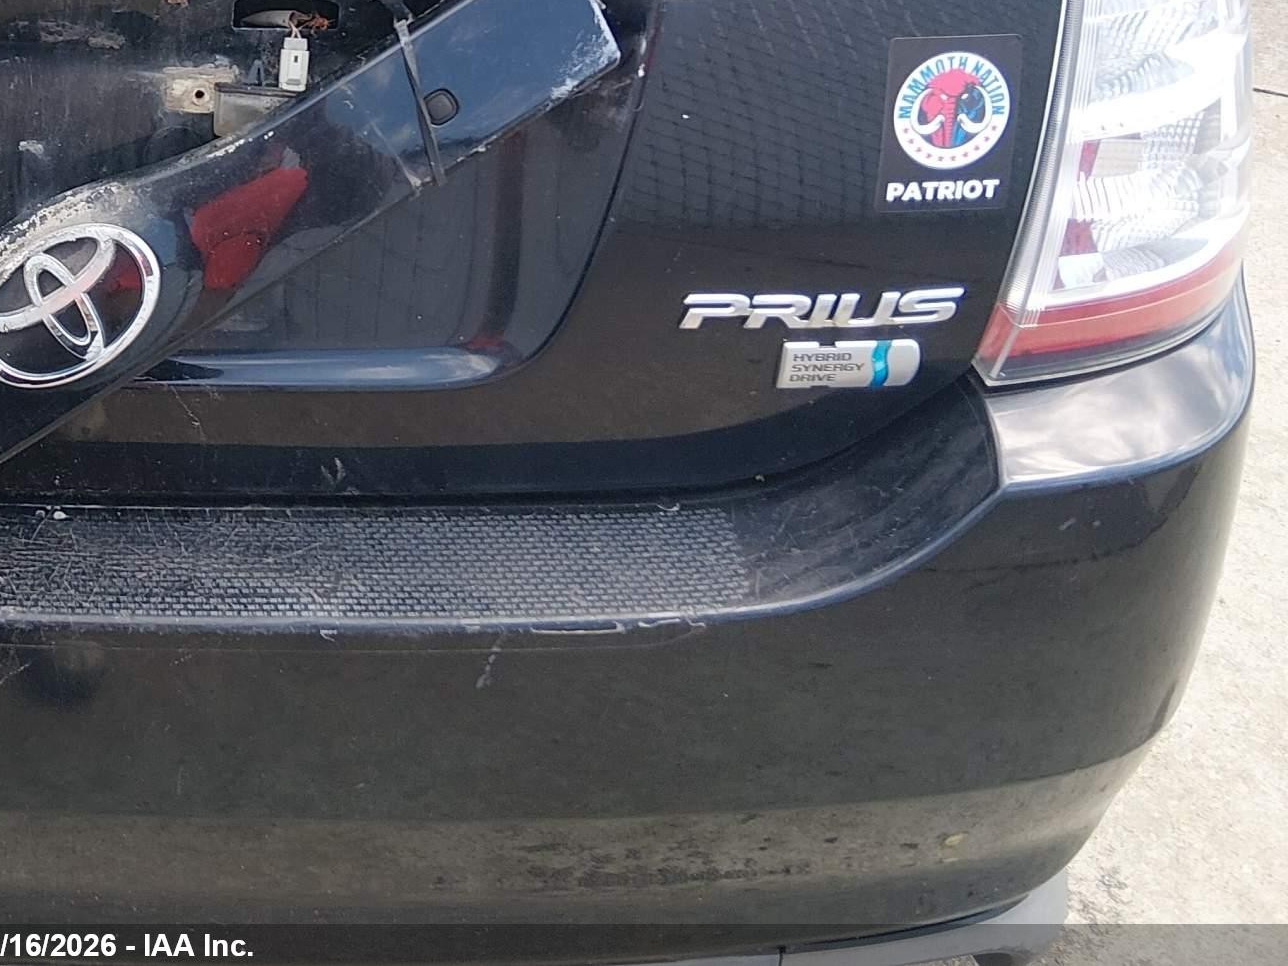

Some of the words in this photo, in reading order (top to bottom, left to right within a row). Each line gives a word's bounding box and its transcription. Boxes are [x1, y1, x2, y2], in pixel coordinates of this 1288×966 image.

[898, 56, 969, 119] MAMMOTH
[971, 62, 1006, 116] NATION
[885, 179, 1000, 202] PATRIOT
[679, 287, 965, 329] PRIUS
[793, 352, 852, 363] HYBRID
[791, 363, 864, 374] SYNERGY
[789, 374, 836, 383] DRIVE
